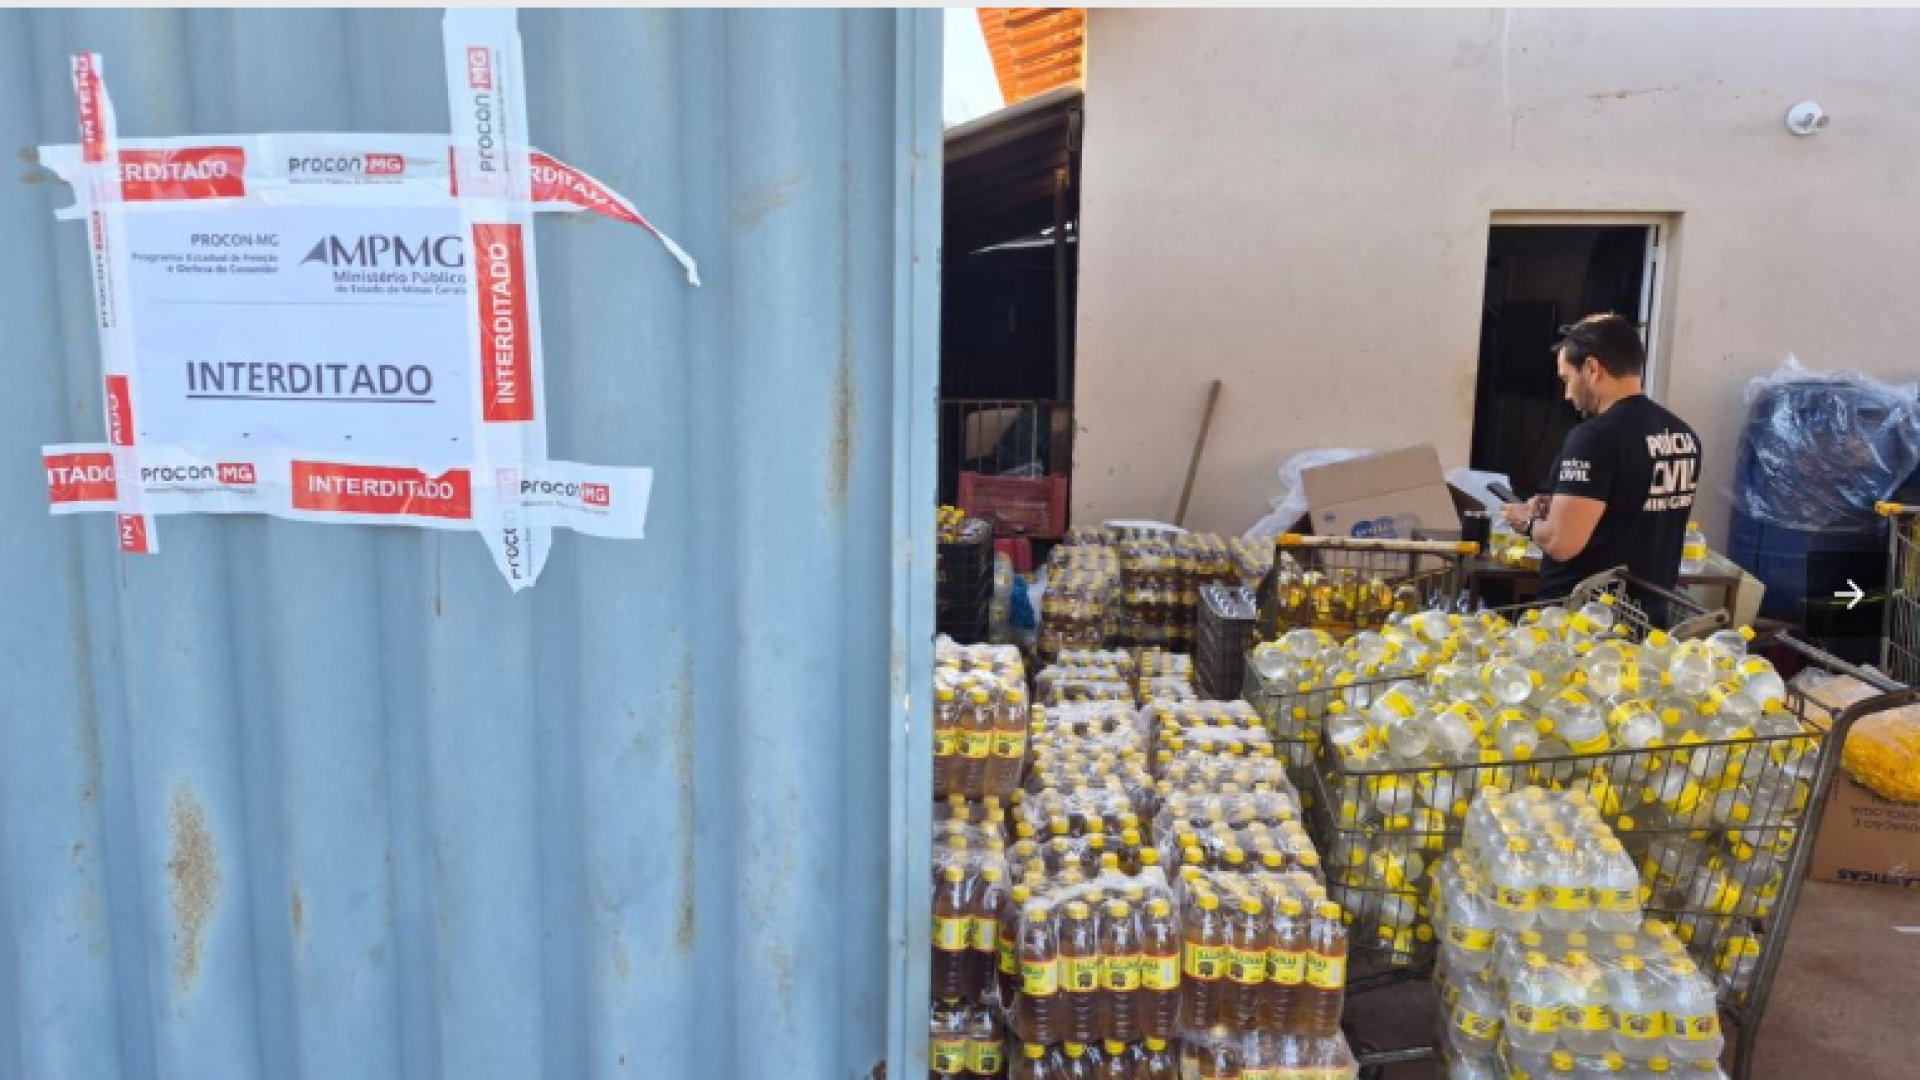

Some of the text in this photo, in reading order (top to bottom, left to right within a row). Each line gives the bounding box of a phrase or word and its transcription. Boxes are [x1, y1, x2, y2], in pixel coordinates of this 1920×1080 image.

[117, 160, 228, 182] ERDITADO
[190, 233, 280, 247] PROCON-MG
[329, 233, 466, 268] MPMG
[488, 243, 517, 403] INTERDITADO
[186, 361, 434, 396] INTERDITADO
